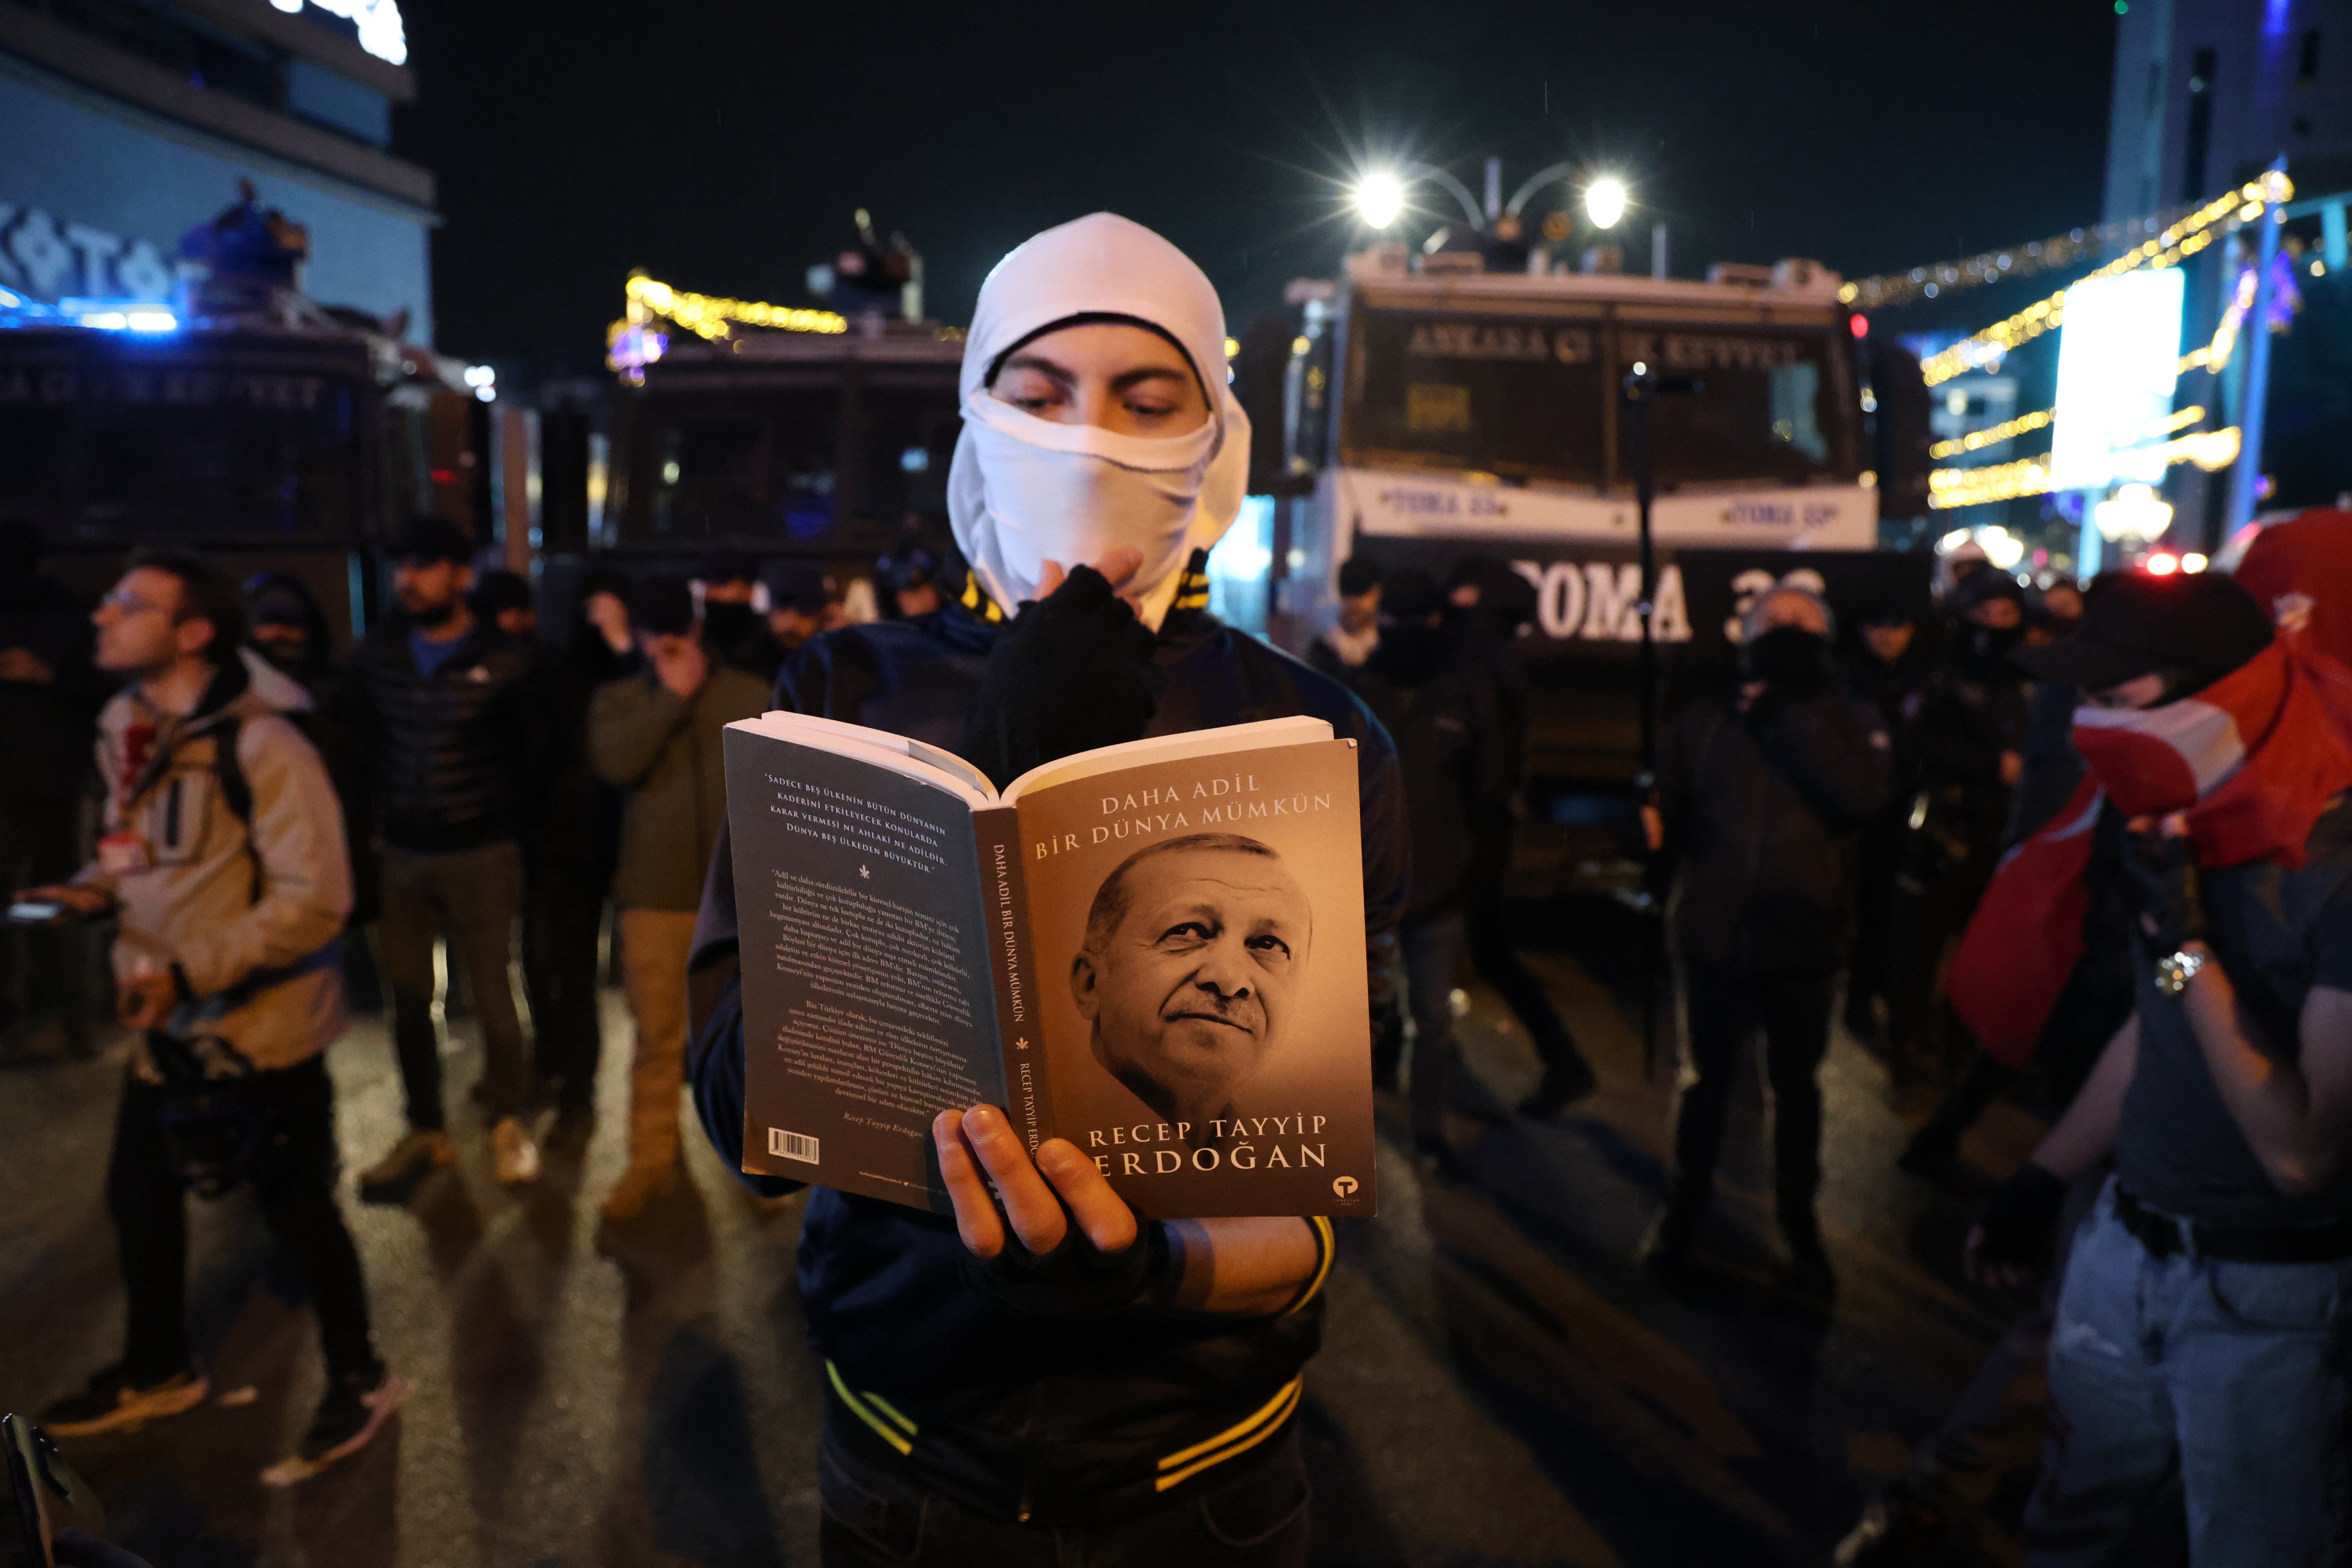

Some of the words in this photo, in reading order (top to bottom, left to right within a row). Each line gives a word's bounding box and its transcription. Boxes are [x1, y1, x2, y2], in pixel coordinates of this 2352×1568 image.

[805, 784, 820, 796] BEŞ
[866, 800, 896, 817] BÜTÜN
[900, 811, 946, 836] DÜNYANIN
[1102, 786, 1180, 815] DAHA
[1192, 773, 1259, 799] ADİL
[770, 805, 799, 818] KARAR
[801, 813, 840, 829] VERMESİ
[843, 823, 855, 833] NE
[858, 828, 891, 844] AHLAKİ
[894, 840, 905, 849] NE
[908, 845, 947, 866] ADİLDİR.
[777, 792, 821, 809] KADERİNİ
[824, 804, 882, 827] ETKİLEYECEK
[885, 821, 938, 848] KONULARDA
[786, 822, 818, 838] DÜNYA
[821, 832, 837, 844] BEŞ
[840, 836, 880, 855] ÜLKEDEN
[1036, 834, 1080, 860] BİR
[1092, 812, 1189, 844] DÜNYA
[1203, 794, 1330, 824] MÜMKÜN
[994, 844, 1007, 878] DAHA
[798, 875, 814, 886] daha
[815, 881, 858, 897] sürdürülebilir
[858, 891, 868, 900] bir
[869, 894, 892, 908] küresel
[892, 901, 914, 916] barışın
[914, 911, 935, 924] temini
[936, 919, 947, 929] için
[948, 925, 960, 934] çok
[998, 880, 1012, 907] ADİL
[782, 902, 792, 912] bir
[793, 905, 821, 919] kültürün
[831, 915, 840, 924] de
[840, 917, 860, 931] birkaç
[861, 923, 886, 936] imtiyaz
[886, 932, 905, 943] sahibi
[906, 938, 931, 952] aktörün
[931, 946, 955, 962] kültürel
[797, 895, 818, 909] Dünya
[829, 905, 840, 913] tek
[840, 906, 866, 920] kutuplu
[876, 917, 884, 926] de
[885, 920, 894, 929] iki
[941, 939, 960, 954] hâkim
[825, 894, 837, 902] çok
[838, 895, 877, 914] kutupluluğu
[877, 909, 903, 922] yansıtan
[904, 915, 914, 926] bir
[936, 928, 956, 944] ihtiyaç
[1002, 910, 1014, 929] BİR
[782, 933, 806, 946] Böylesi
[806, 939, 817, 948] bir
[817, 942, 837, 955] dünya
[838, 947, 851, 957] için
[851, 951, 861, 960] ilk
[862, 955, 879, 964] adres
[783, 924, 800, 934] daha
[800, 927, 829, 942] kapsayıcı
[838, 938, 851, 947] adil
[852, 940, 862, 950] bir
[862, 944, 883, 956] dünya
[883, 950, 897, 961] inşa
[897, 956, 918, 967] etmek
[845, 929, 860, 939] Çok
[888, 944, 901, 952] çok
[931, 958, 943, 967] çok
[1004, 931, 1017, 970] DÜNYA
[775, 943, 800, 955] adaletin
[809, 952, 827, 961] etkin
[828, 955, 851, 967] küresel
[851, 963, 889, 978] yönetişimin
[933, 989, 958, 1002] reforma
[958, 998, 970, 1008] tabi
[865, 975, 879, 985] BM
[880, 981, 906, 993] reformu
[915, 991, 942, 1006] özellikle
[942, 1000, 971, 1018] Güvenlik
[845, 982, 871, 993] yeniden
[917, 1002, 939, 1014] elbette
[940, 1010, 953, 1019] tüm
[953, 1014, 973, 1028] dünya
[846, 991, 886, 1007] uzlaşmasıyla
[886, 1000, 907, 1014] hayata
[1009, 973, 1024, 1022] MÜMKÜN
[1020, 1063, 1032, 1092] RECEP
[1024, 1094, 1038, 1126] TAYYİP
[1089, 1122, 1191, 1147] RECEP
[1209, 1112, 1326, 1137] TAYYİP
[1092, 1141, 1326, 1176] ERDOĞAN
